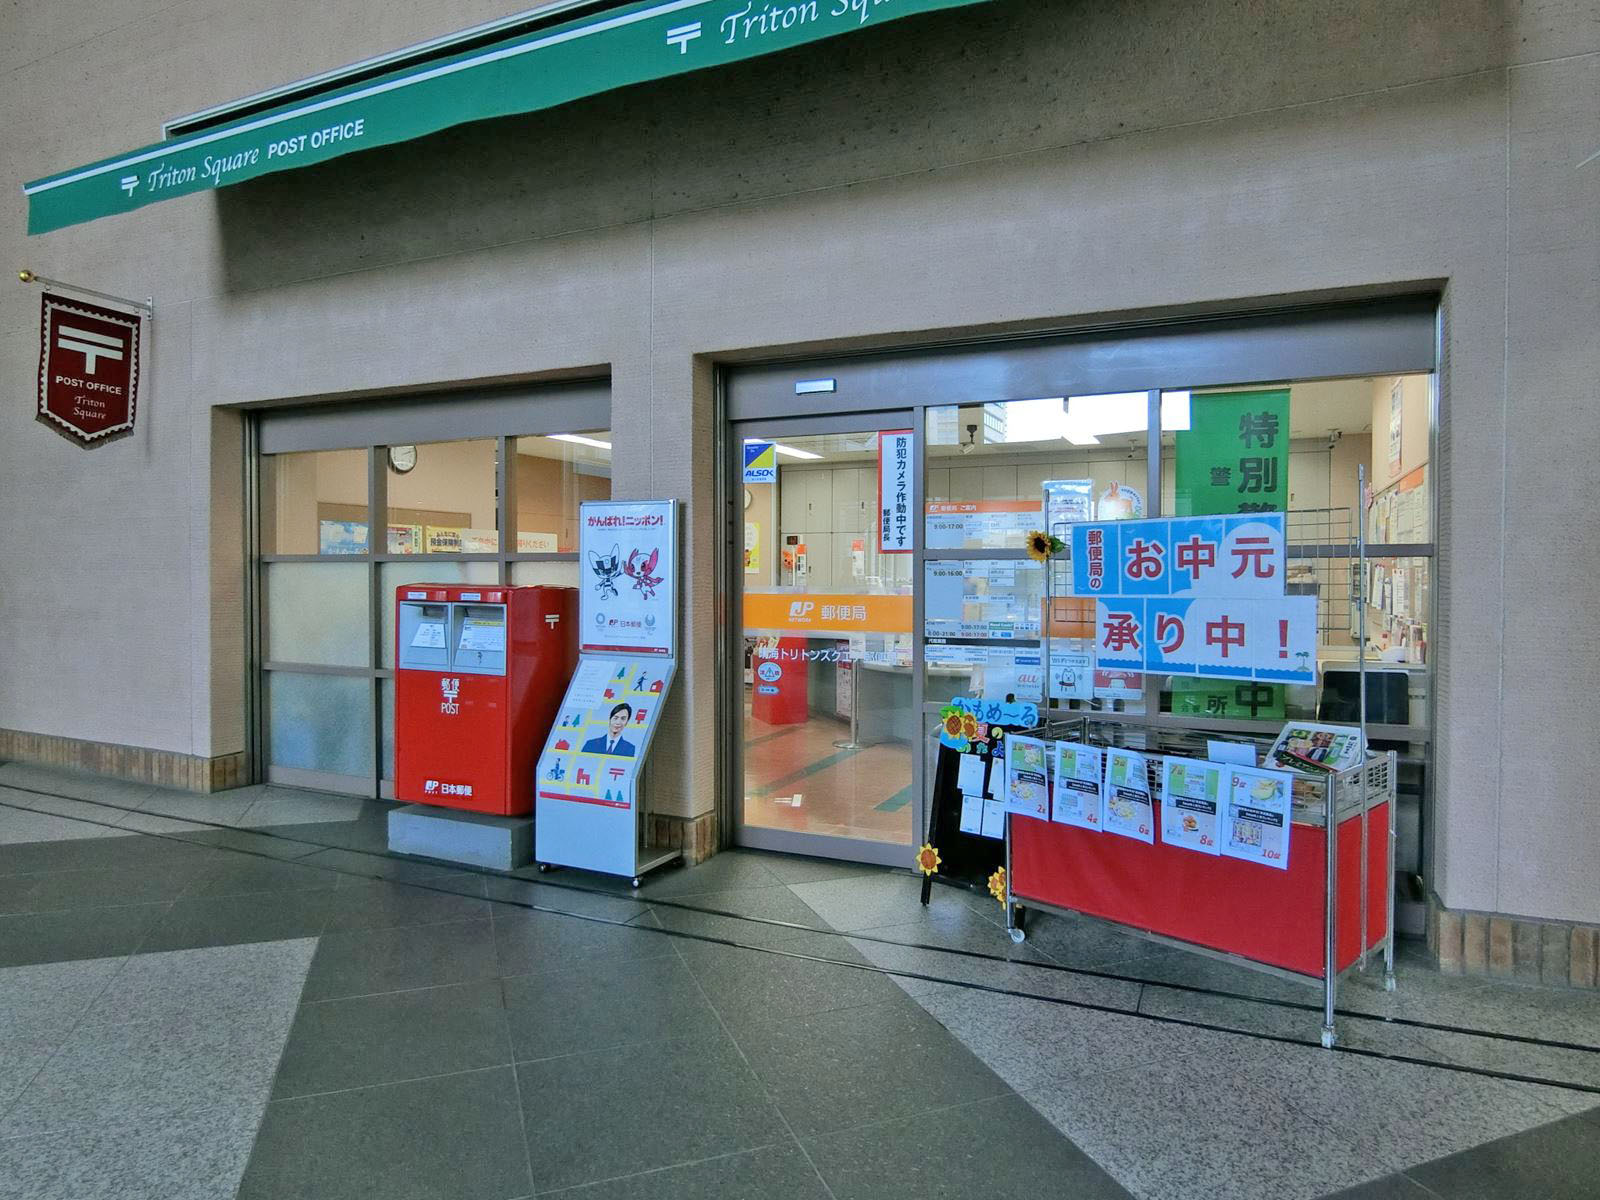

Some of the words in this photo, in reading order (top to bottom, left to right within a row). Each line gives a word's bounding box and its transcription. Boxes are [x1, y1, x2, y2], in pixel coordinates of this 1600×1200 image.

[720, 0, 819, 44] Triton
[831, 0, 896, 25] Sq
[148, 162, 197, 192] Triton
[201, 148, 260, 186] Square
[267, 135, 308, 159] POST
[311, 119, 365, 149] OFFICE
[56, 375, 84, 388] POST
[86, 381, 122, 394] OFFICE
[74, 394, 106, 408] Triton
[73, 407, 106, 420] Square
[1237, 411, 1279, 513] 特別
[745, 469, 775, 478] ALSOK
[895, 437, 907, 547] 防犯カメラ作動中です
[882, 508, 891, 542] 郵便局長
[1087, 529, 1103, 590] 郵便局の
[1126, 536, 1276, 580] お中元
[821, 605, 867, 621] 郵便局
[1102, 613, 1289, 659] 承り中！
[440, 678, 460, 692] 郵便
[1017, 674, 1039, 683] au
[440, 702, 460, 715] POST
[441, 783, 473, 797] 日本郵便
